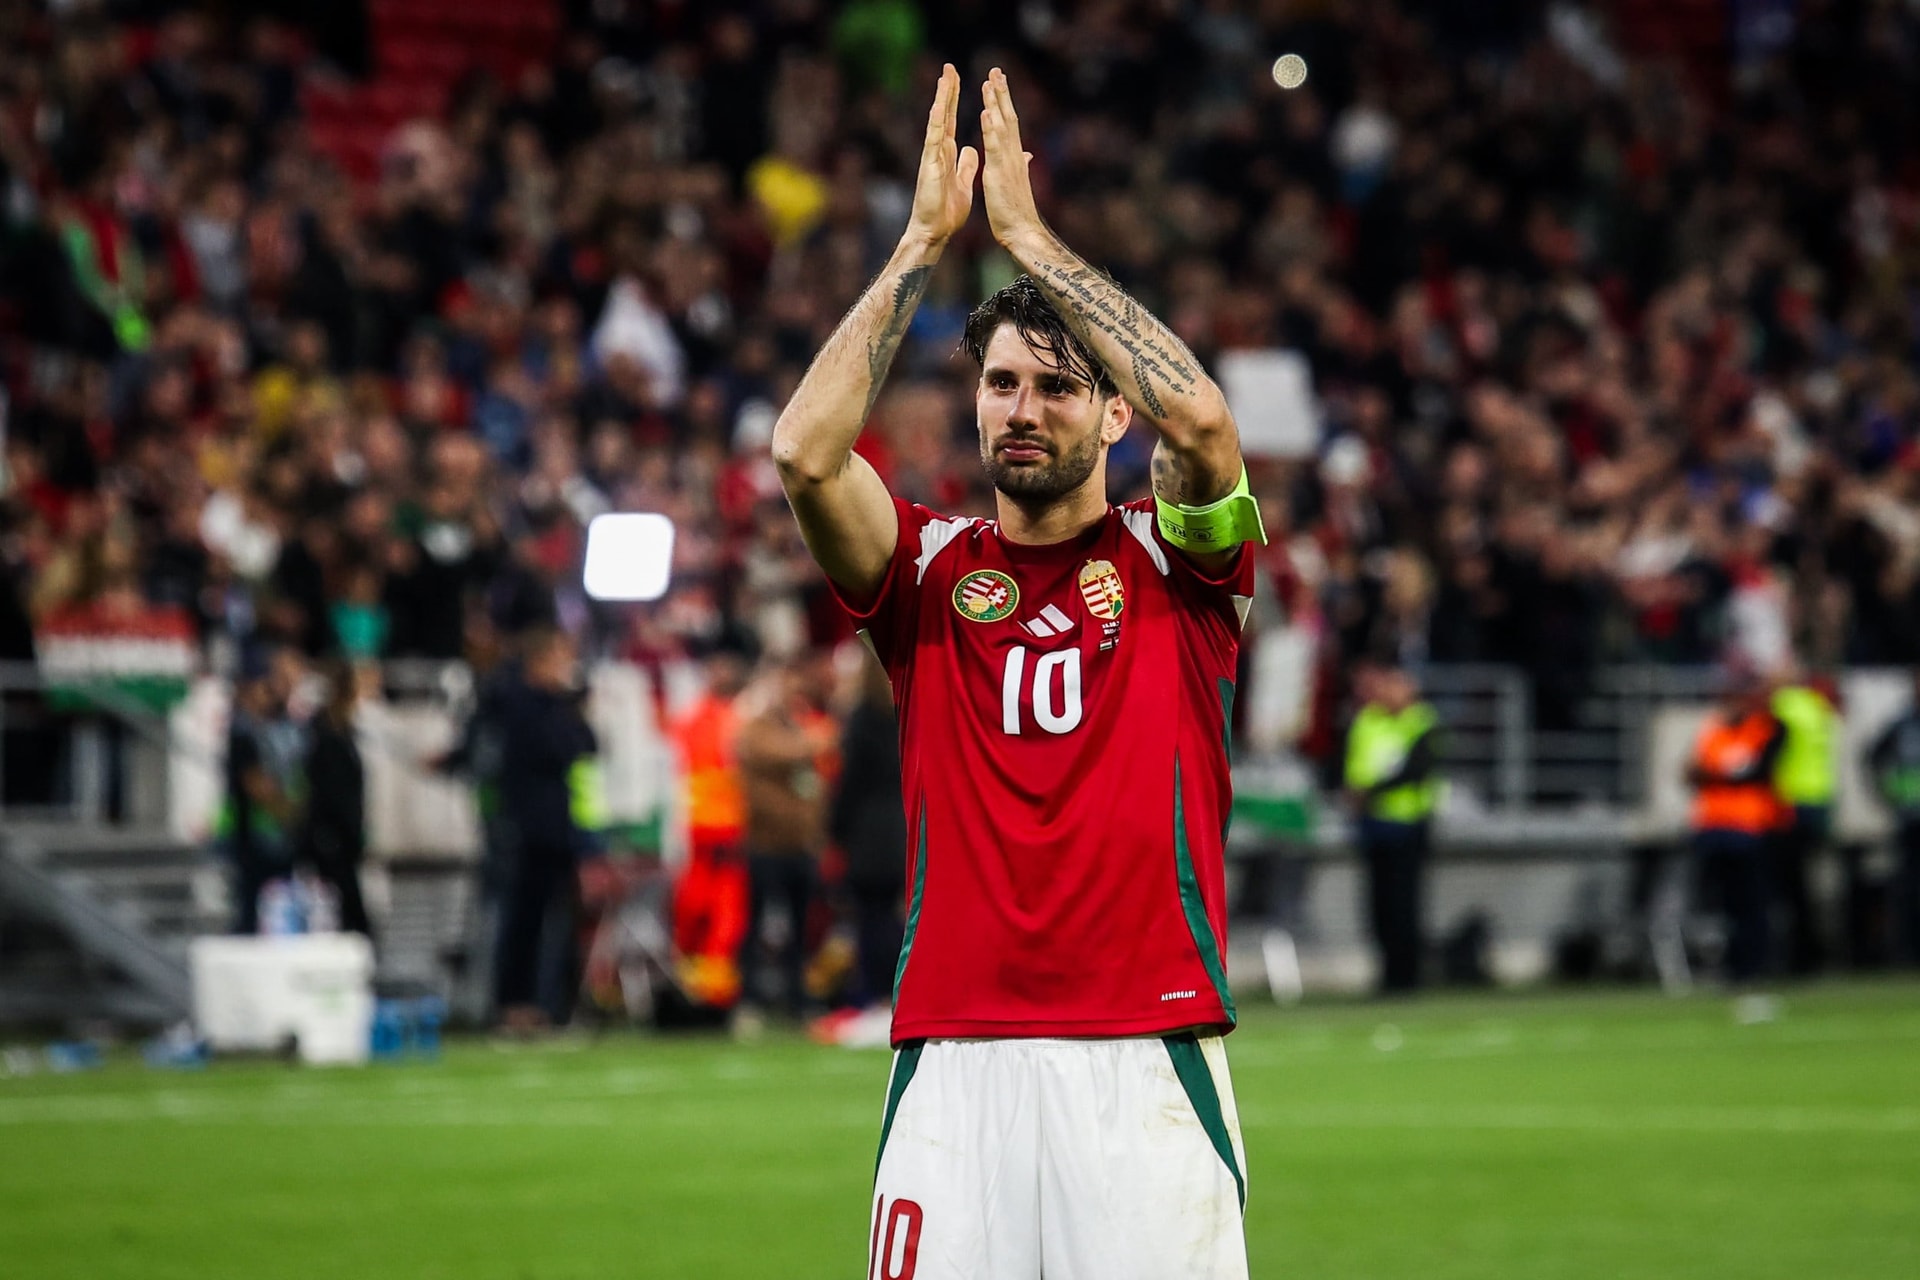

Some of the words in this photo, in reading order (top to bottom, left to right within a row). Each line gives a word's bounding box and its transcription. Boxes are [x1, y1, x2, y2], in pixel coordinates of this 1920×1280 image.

[1002, 645, 1083, 735] 10
[1161, 990, 1196, 1002] AEROREADY
[868, 1193, 923, 1280] 10
